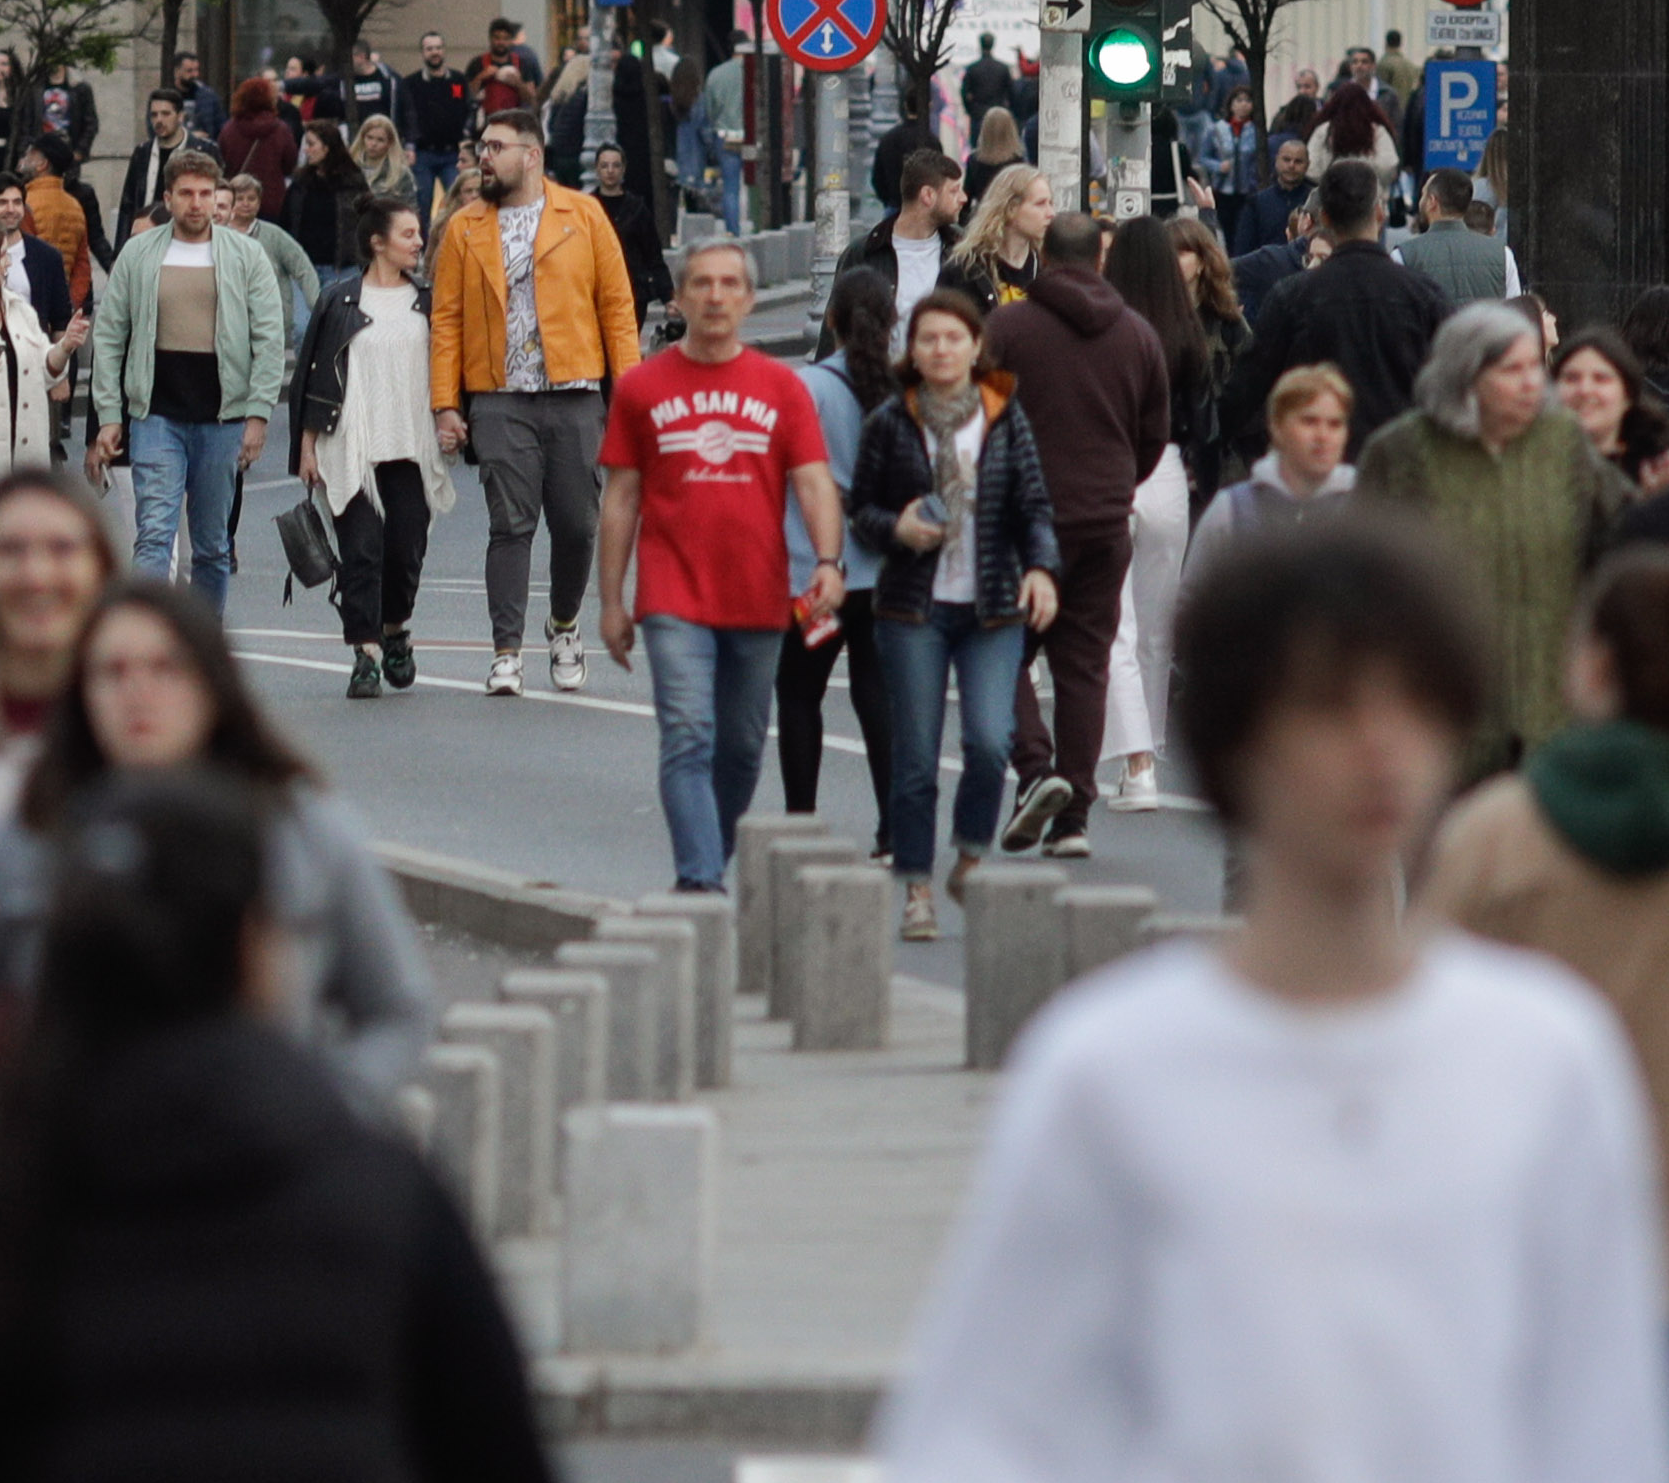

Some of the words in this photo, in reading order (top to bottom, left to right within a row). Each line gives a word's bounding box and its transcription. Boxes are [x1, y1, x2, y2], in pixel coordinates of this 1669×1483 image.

[1440, 71, 1479, 138] P
[650, 396, 691, 429] MIA
[692, 390, 739, 415] SAN
[741, 396, 778, 432] MIA
